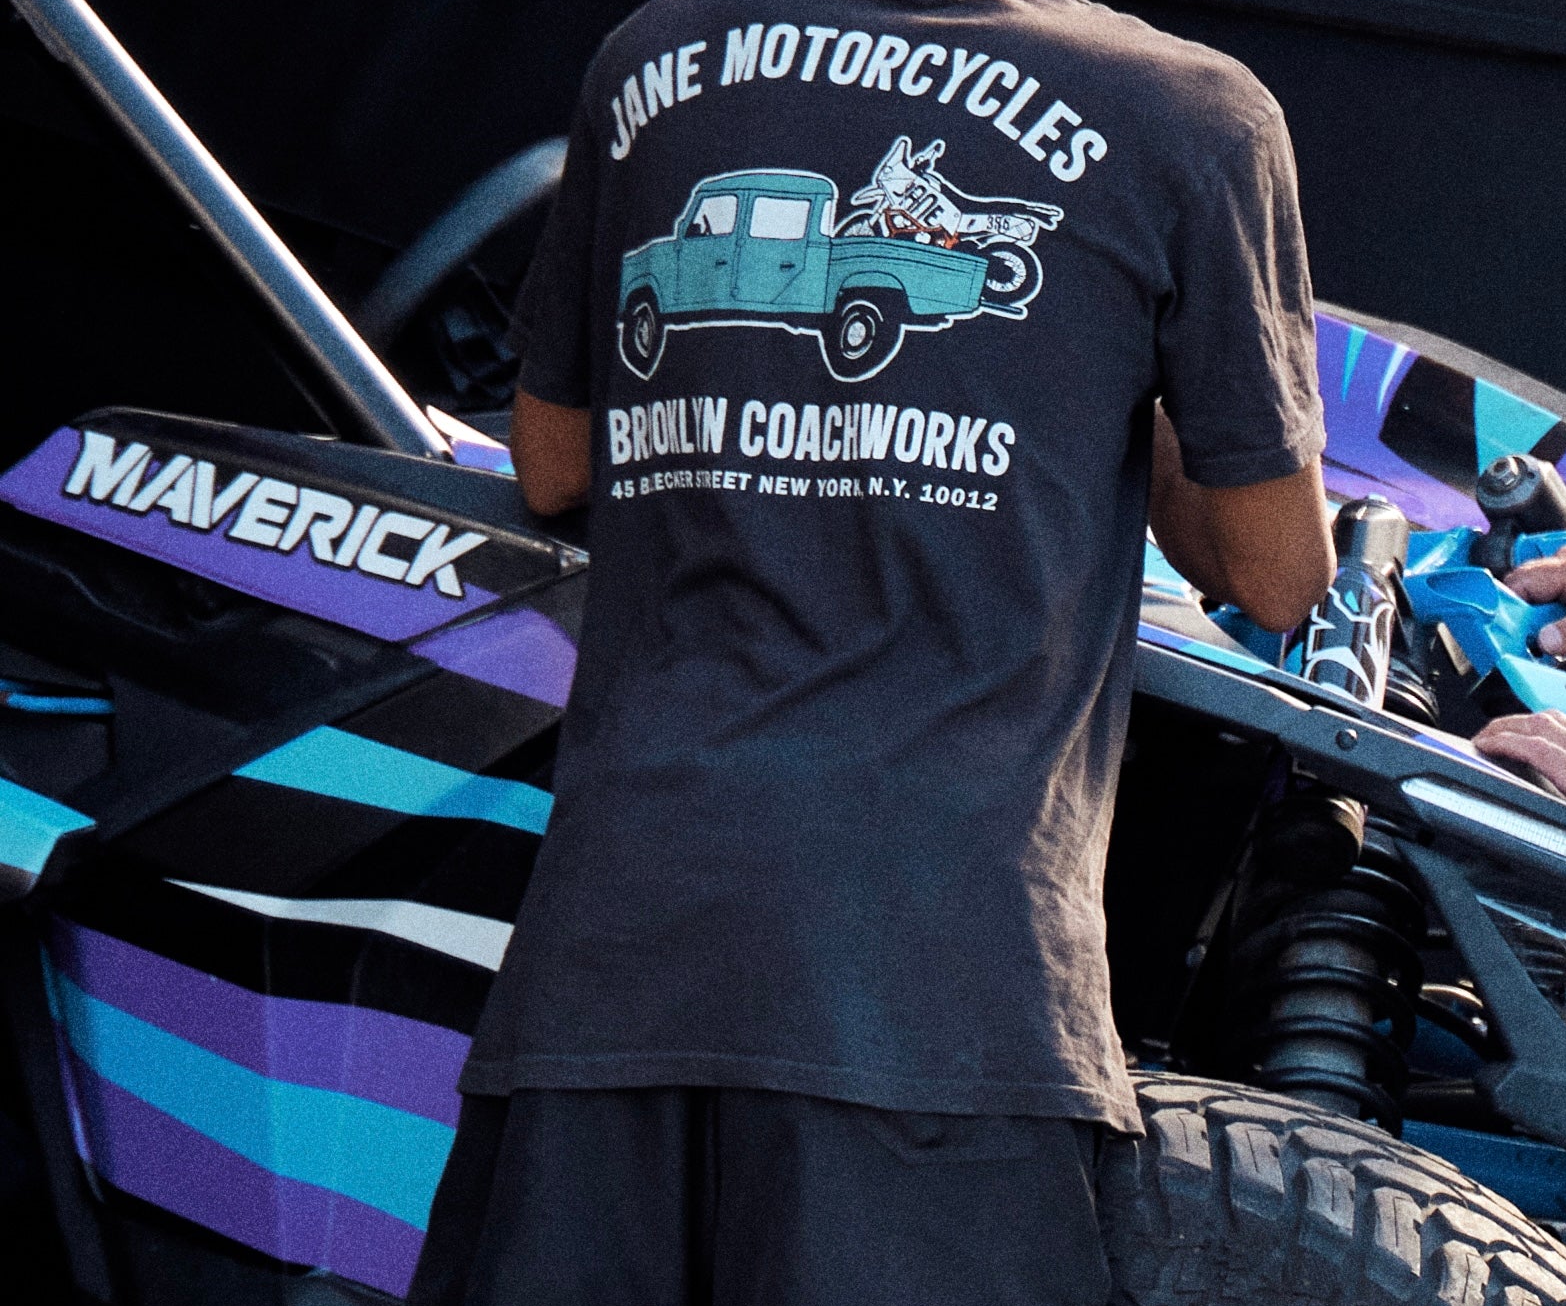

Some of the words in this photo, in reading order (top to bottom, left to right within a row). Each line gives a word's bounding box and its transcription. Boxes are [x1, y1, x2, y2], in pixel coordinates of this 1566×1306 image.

[610, 40, 707, 161] JANE
[720, 23, 1108, 183] MOTORCYCLES
[892, 182, 945, 228] JANE
[608, 396, 728, 465] BROKLYN
[739, 399, 1016, 477] COACHWORKS
[65, 430, 488, 597] MAVERICK
[611, 480, 635, 500] 45
[757, 474, 811, 497] NEW
[868, 476, 911, 499] N.Y.
[919, 483, 999, 512] 10012
